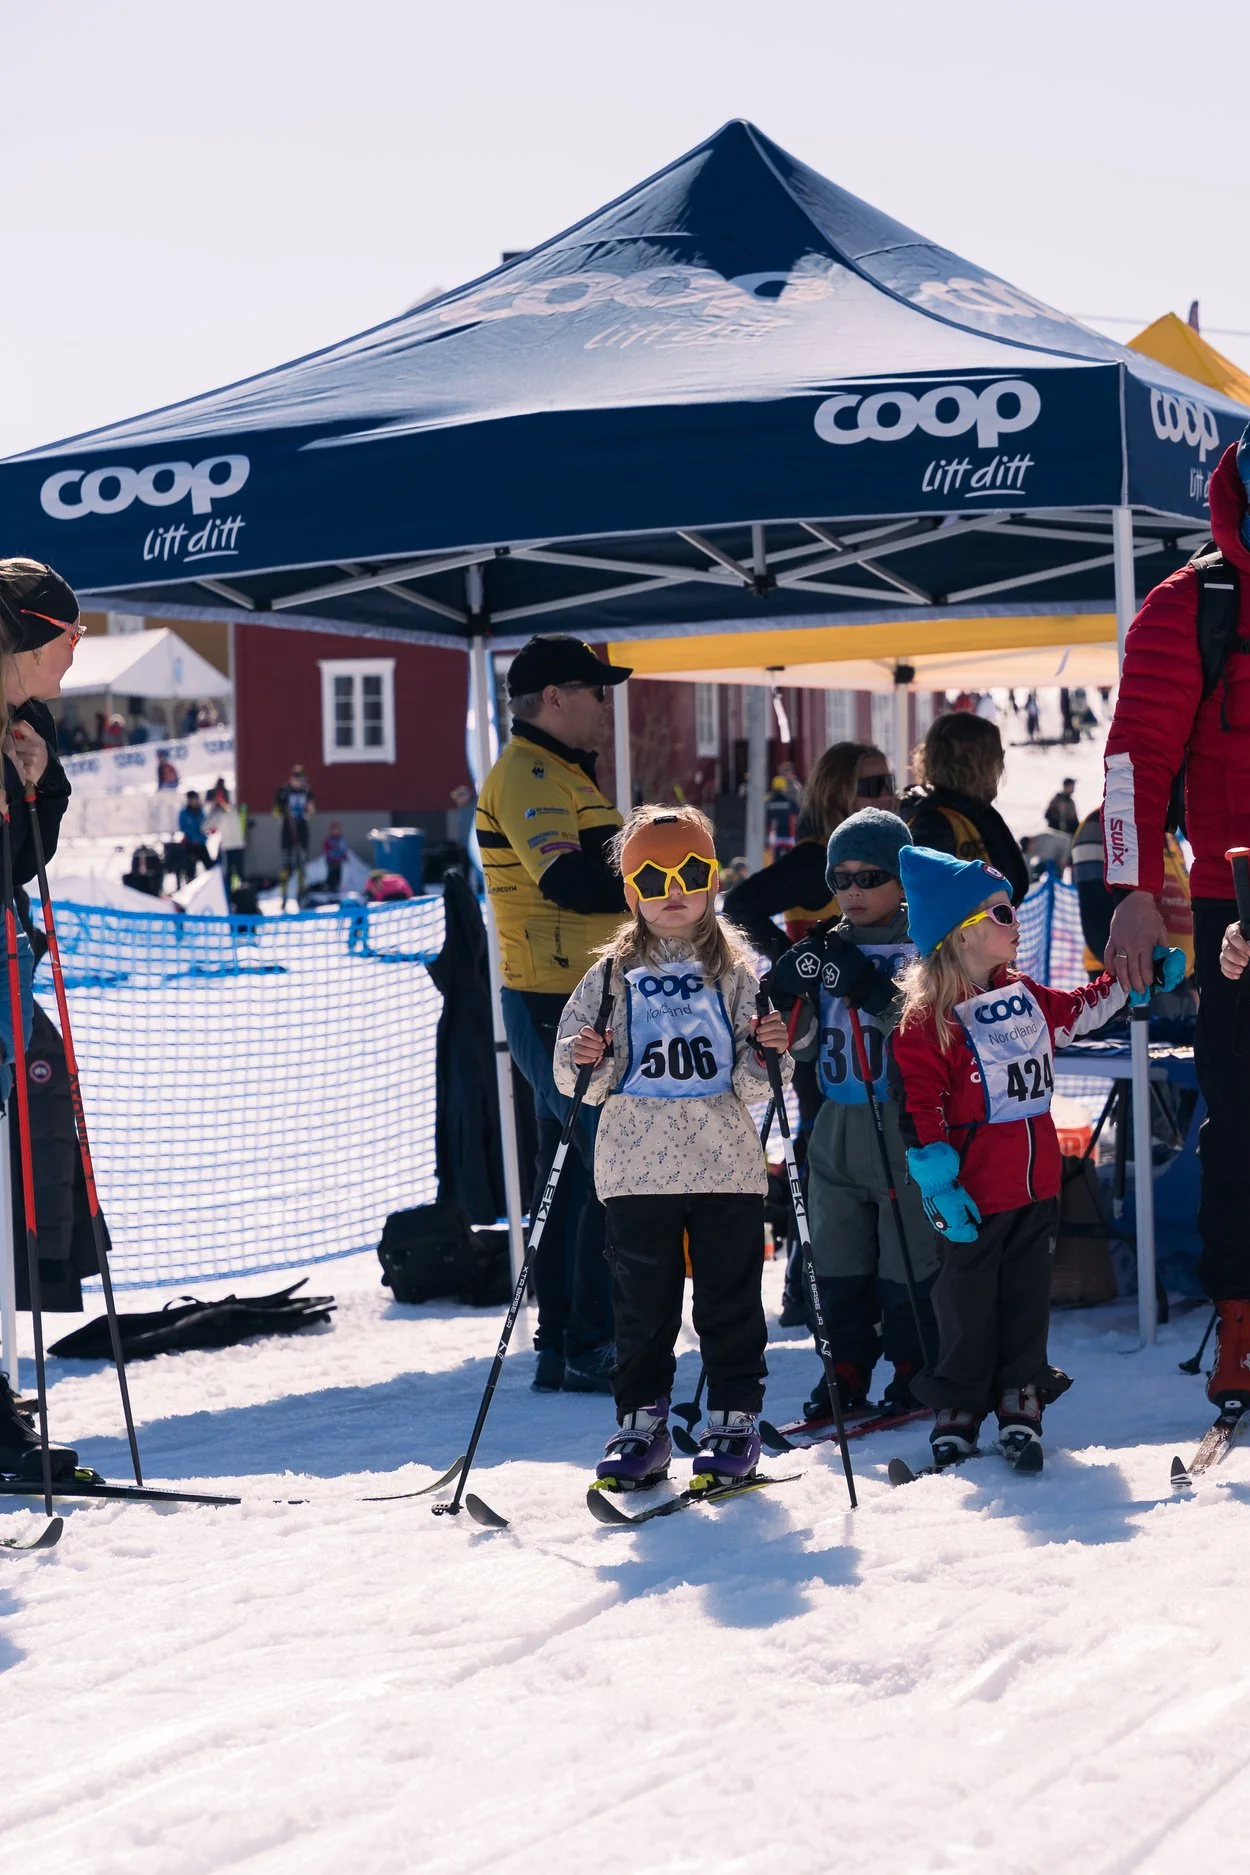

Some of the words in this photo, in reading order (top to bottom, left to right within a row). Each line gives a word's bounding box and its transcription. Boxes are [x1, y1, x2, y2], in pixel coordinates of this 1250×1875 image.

[813, 379, 1041, 449] coop
[1151, 388, 1220, 463] coop
[39, 454, 251, 520] coop
[921, 458, 973, 494] litt
[963, 453, 1034, 498] ditt
[143, 528, 188, 562] litt
[182, 515, 246, 563] ditt
[640, 1035, 719, 1081] 506
[988, 1021, 1039, 1046] Nordland
[1006, 1052, 1056, 1103] 424
